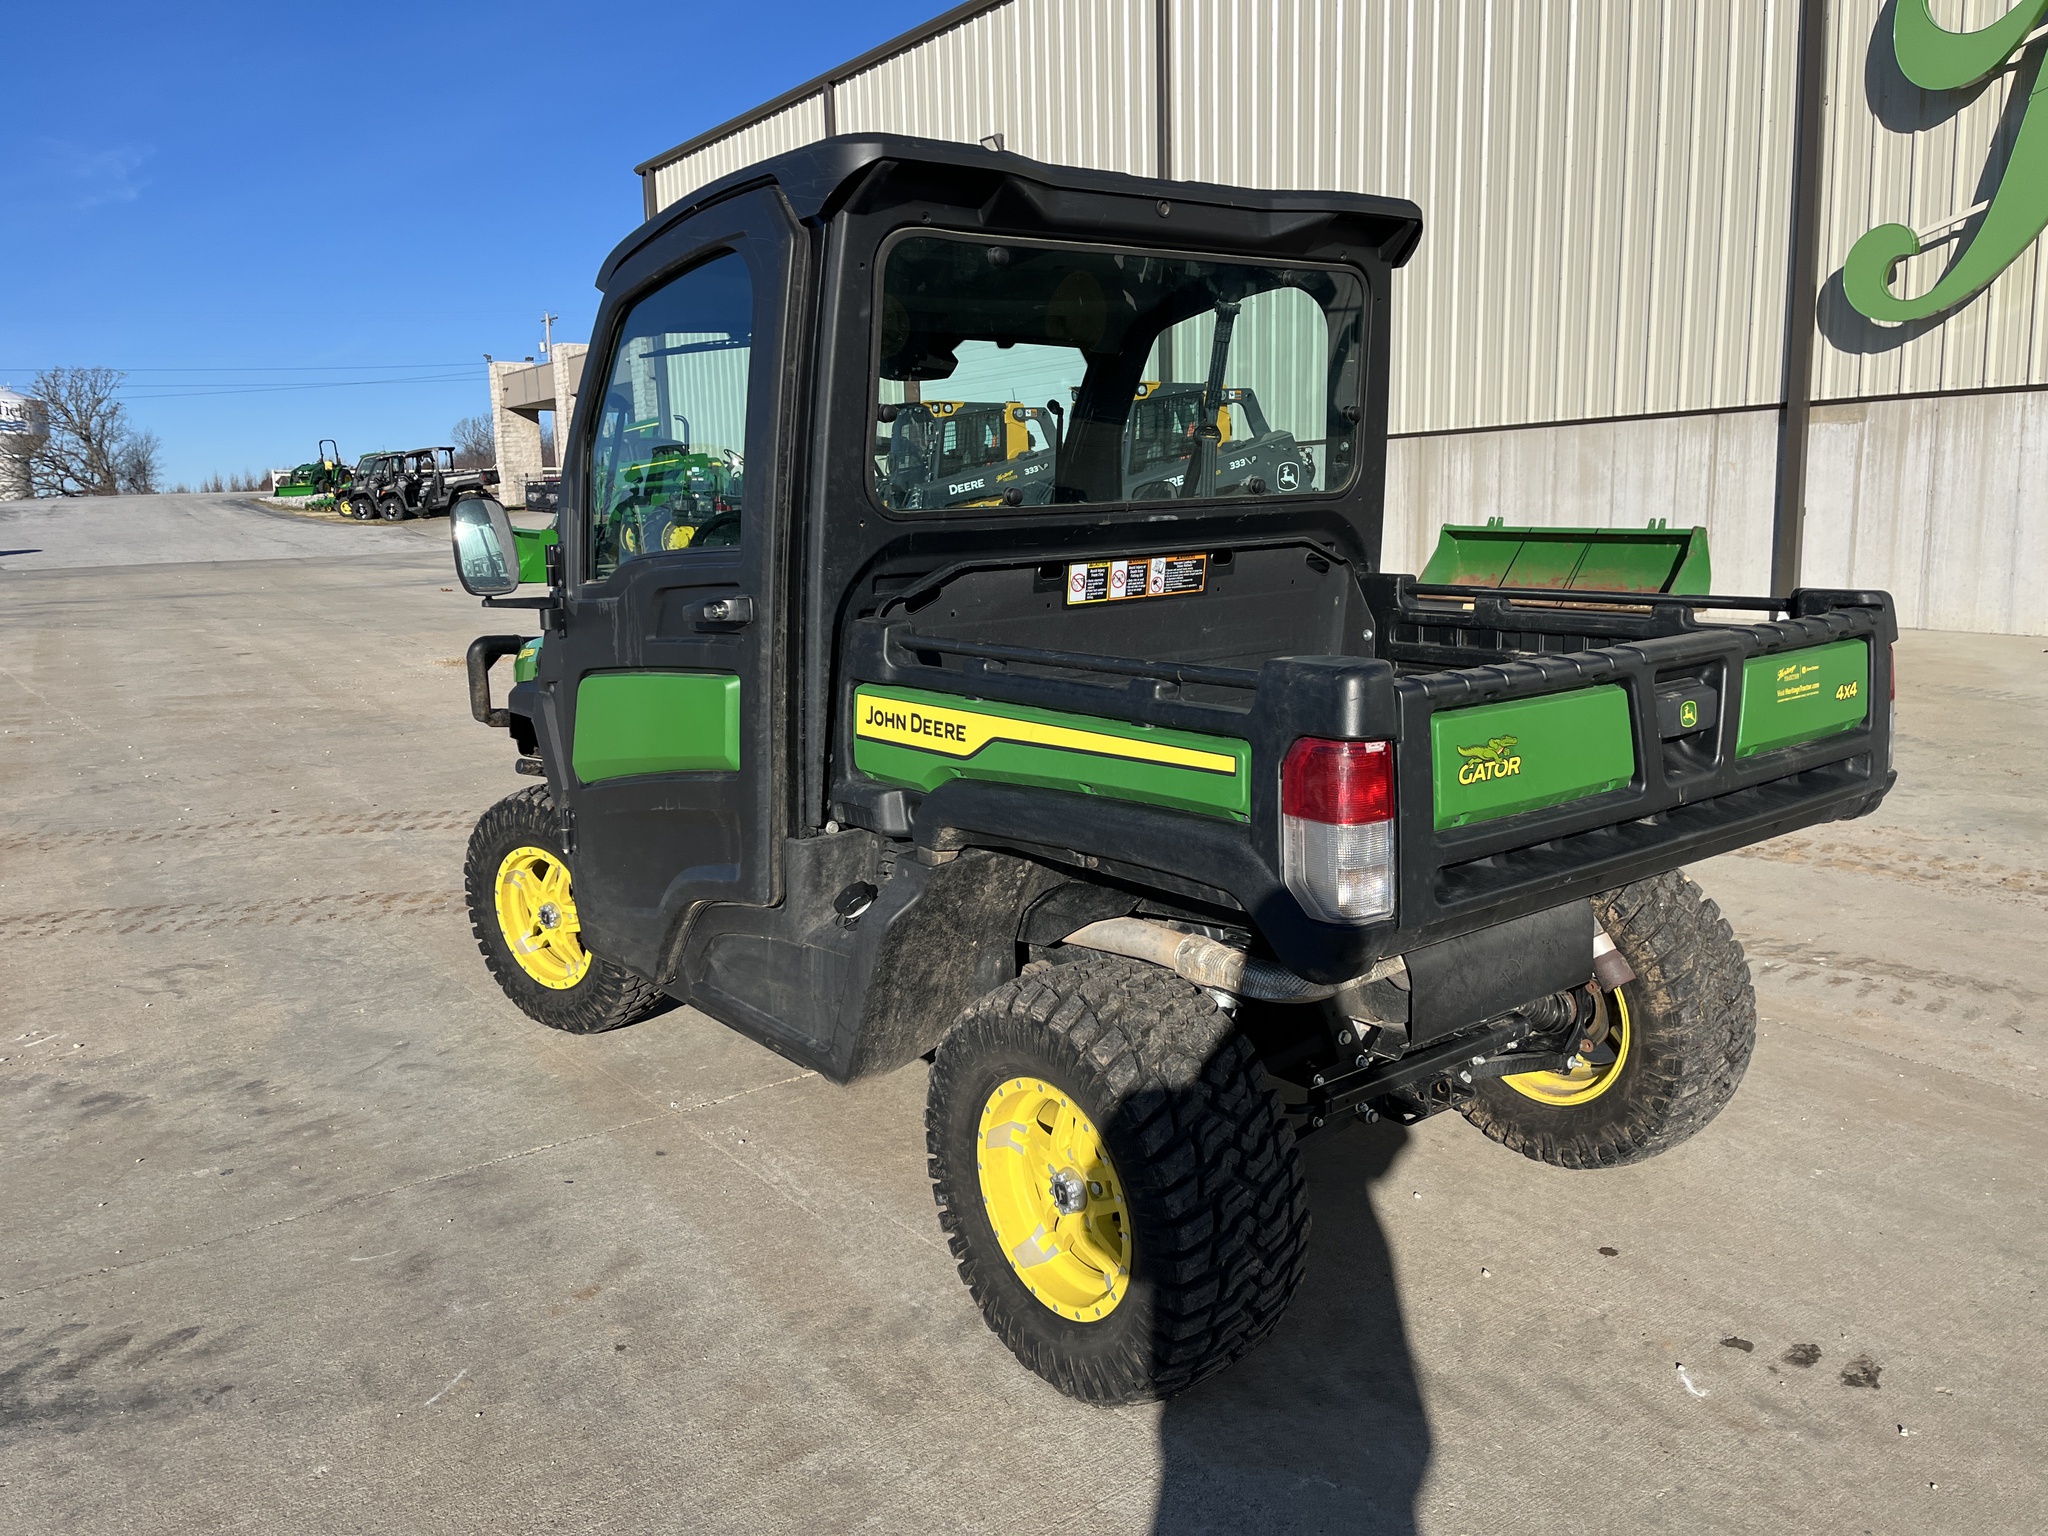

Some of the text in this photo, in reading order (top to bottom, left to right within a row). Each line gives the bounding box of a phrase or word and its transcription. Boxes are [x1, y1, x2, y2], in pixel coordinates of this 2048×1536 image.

[948, 478, 985, 495] DEERE
[865, 705, 967, 742] JOHN DEERE
[1458, 756, 1522, 785] GATOR
